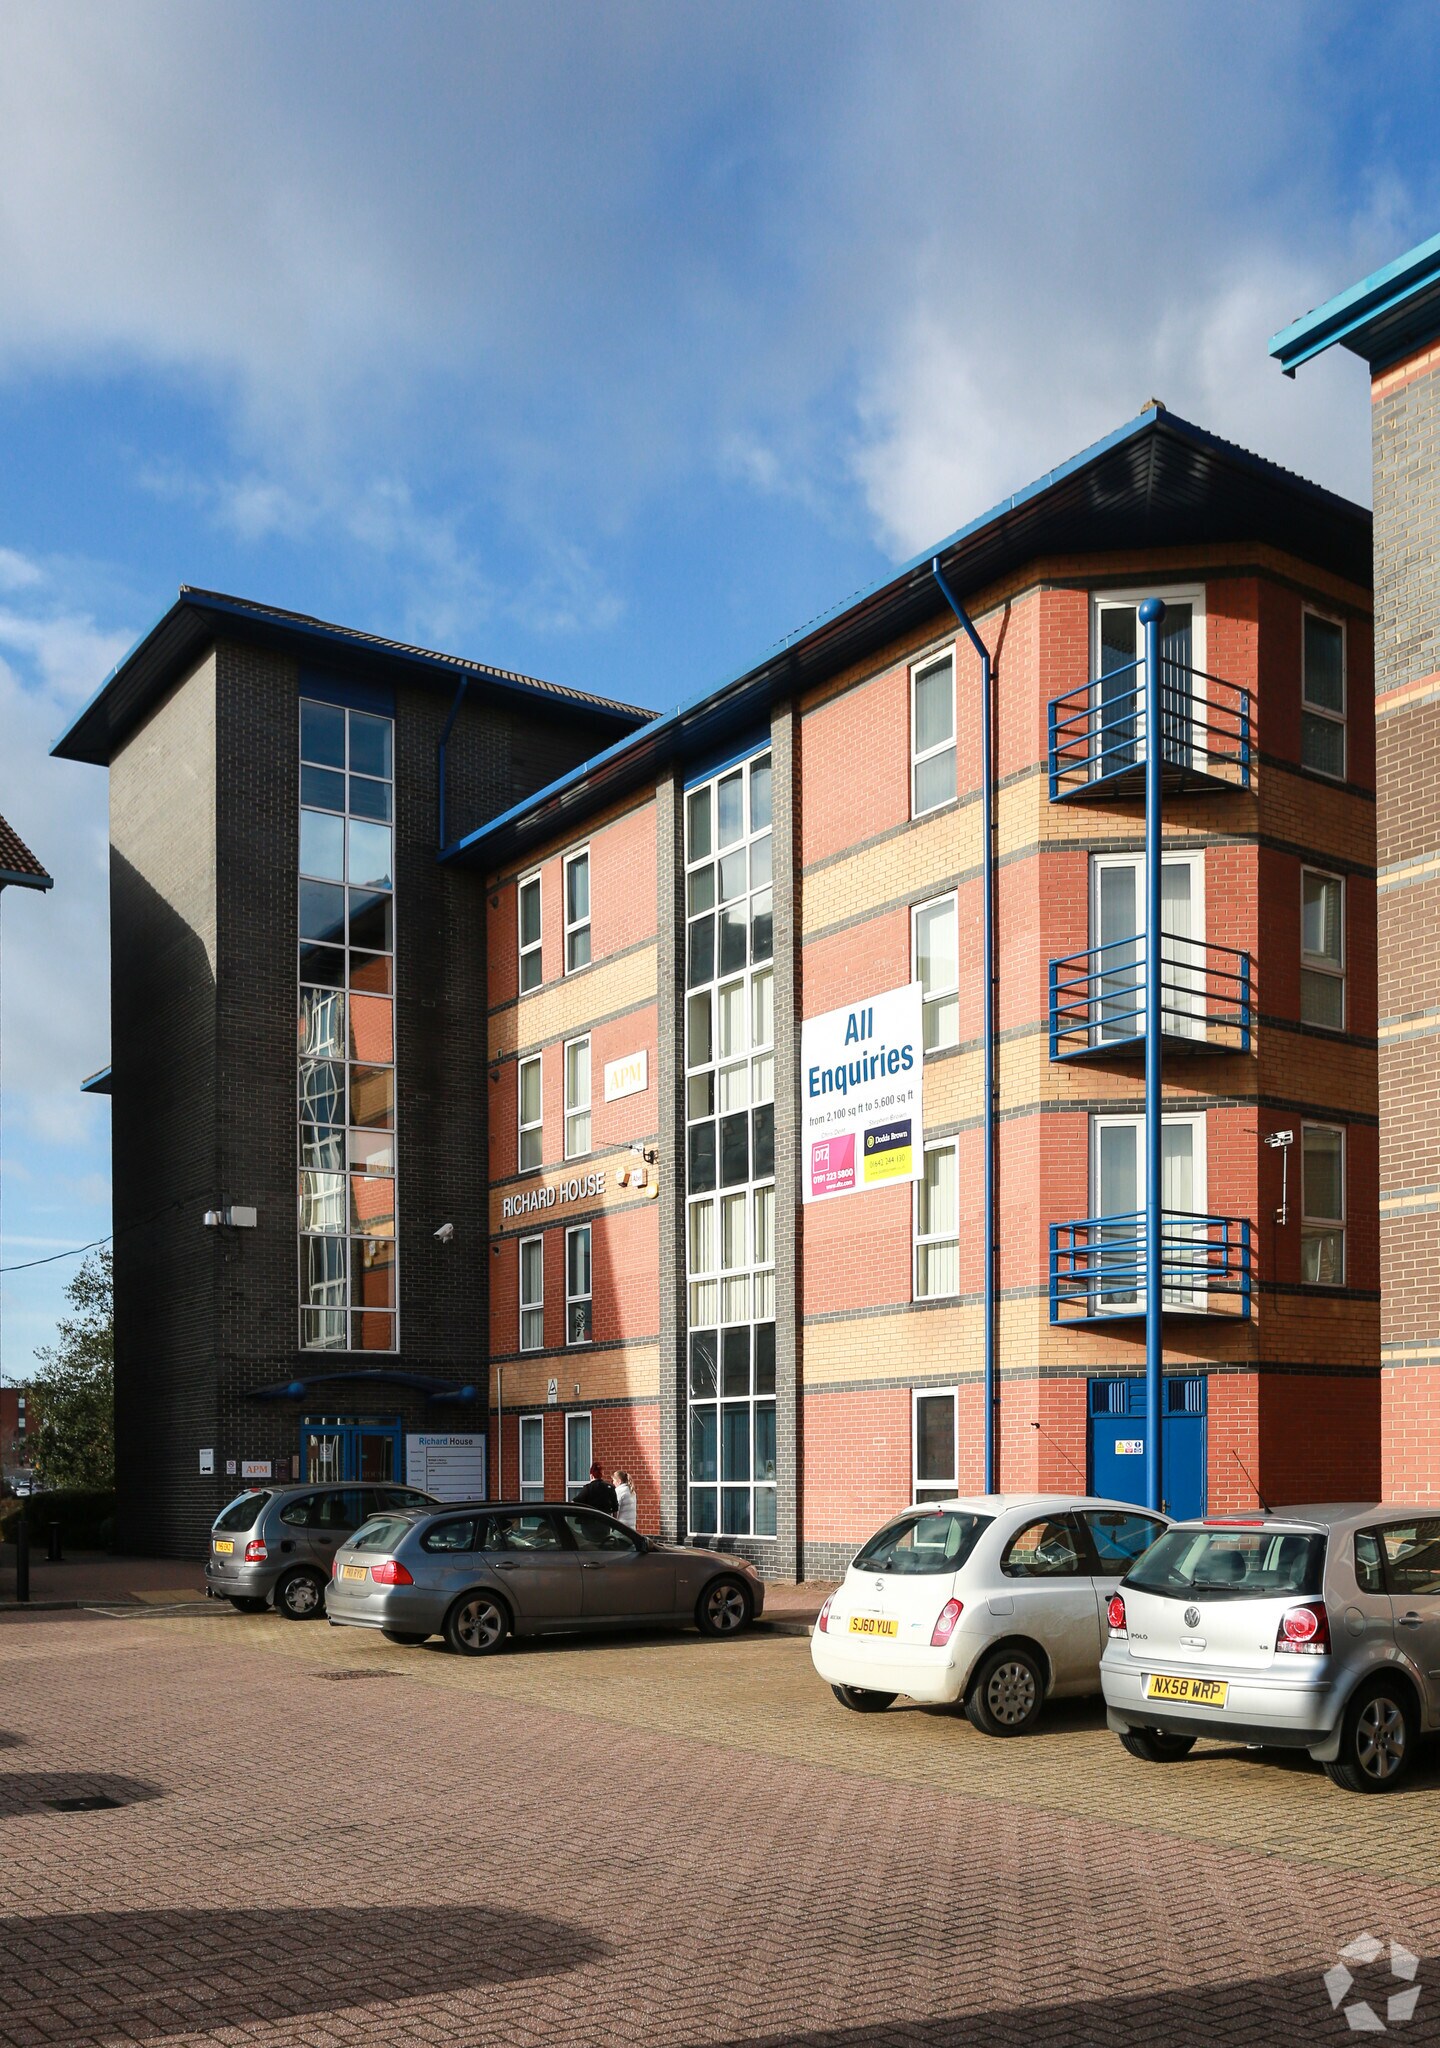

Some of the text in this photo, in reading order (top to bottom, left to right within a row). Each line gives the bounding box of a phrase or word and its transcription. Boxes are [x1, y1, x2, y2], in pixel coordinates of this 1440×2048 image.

[844, 1007, 873, 1046] All
[610, 1062, 641, 1091] APM
[809, 1044, 914, 1098] Enquiries
[809, 1089, 914, 1126] from 2,100 sq ft to 5,600 sq ft
[891, 1131, 908, 1140] Brown
[815, 1147, 828, 1162] DTZ
[813, 1175, 827, 1184] 0191
[826, 1171, 837, 1181] 223
[503, 1172, 605, 1217] RICHARD HOUSE
[419, 1437, 473, 1445] Richard House
[246, 1465, 268, 1474] APM
[852, 1617, 894, 1635] SJ60 YUL
[1153, 1677, 1221, 1700] NX58 WRP
